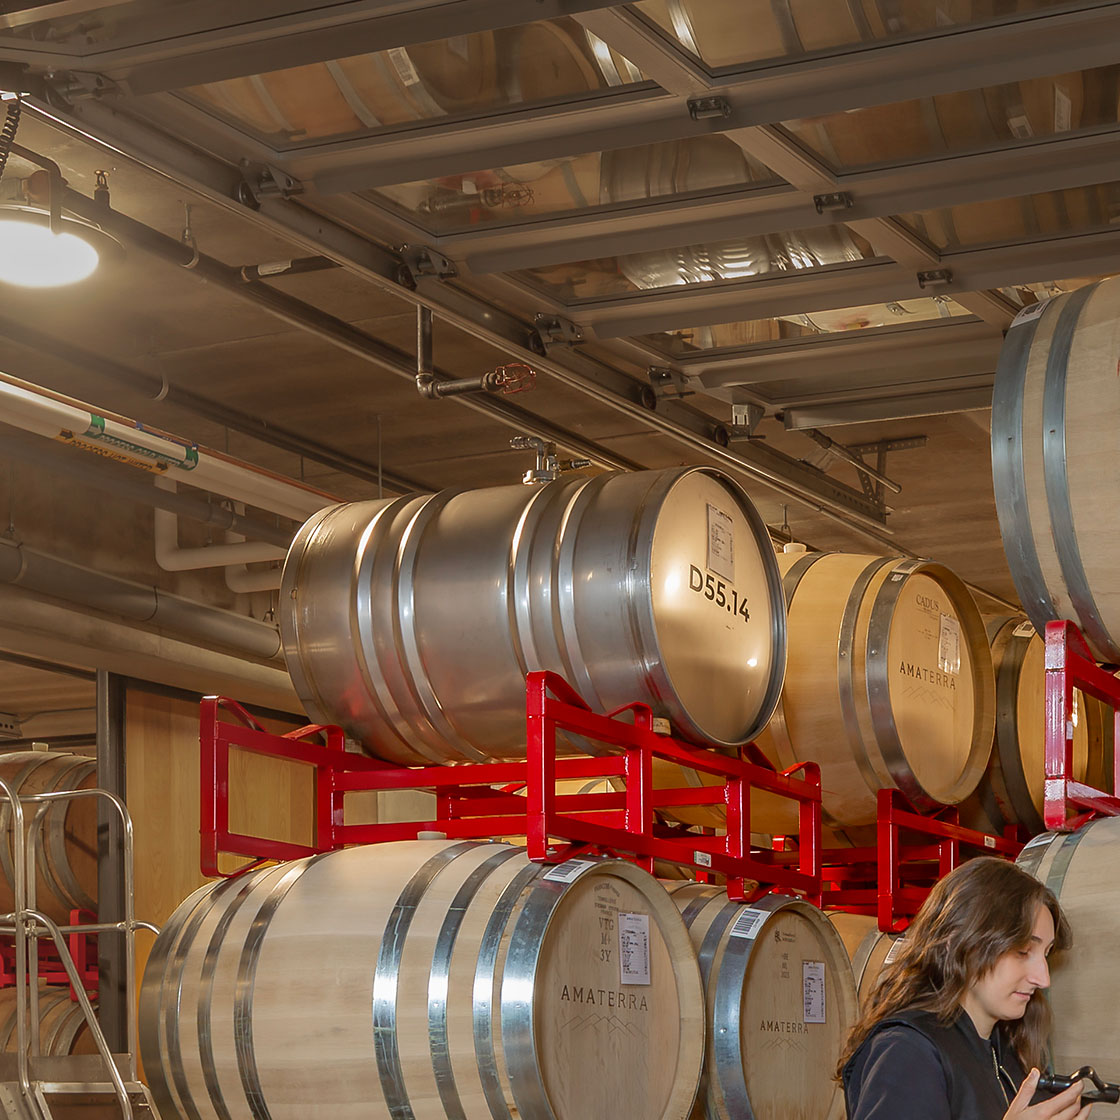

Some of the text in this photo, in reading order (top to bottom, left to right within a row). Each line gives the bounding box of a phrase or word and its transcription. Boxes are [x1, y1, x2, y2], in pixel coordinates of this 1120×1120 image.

[689, 563, 750, 623] D55.14
[915, 594, 940, 612] CADUS
[899, 661, 956, 691] AMATERRA
[598, 916, 615, 931] VTG
[600, 949, 612, 963] 3Y
[560, 984, 649, 1012] AMATERRA
[760, 1020, 809, 1035] AMATERRA
